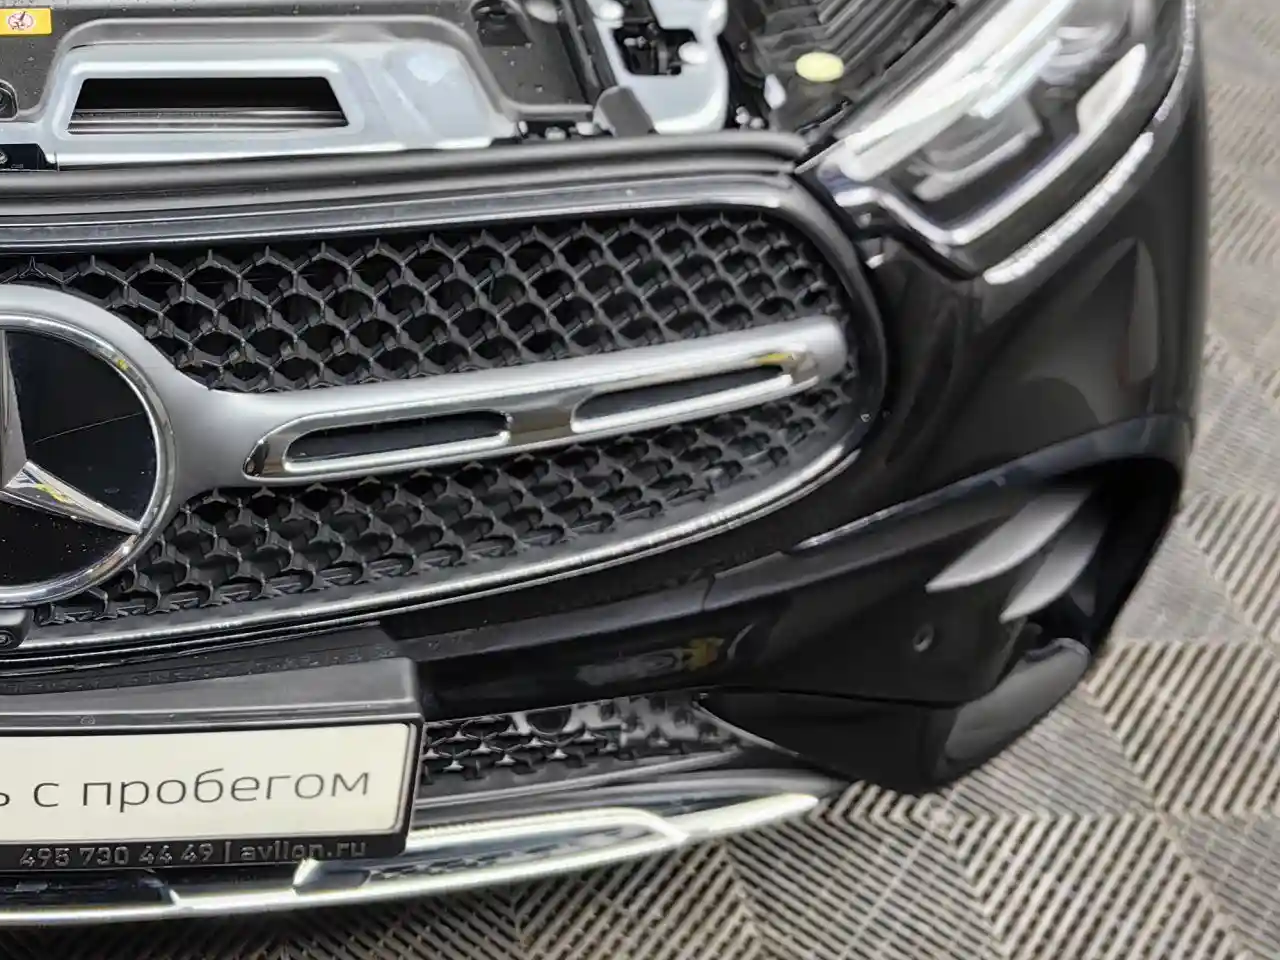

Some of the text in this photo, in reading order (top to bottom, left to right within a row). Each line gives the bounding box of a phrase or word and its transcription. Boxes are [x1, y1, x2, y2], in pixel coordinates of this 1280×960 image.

[33, 781, 60, 808] с
[82, 767, 370, 813] пробегом
[20, 847, 71, 867] 495
[79, 846, 130, 866] 730
[139, 844, 173, 864] 44
[180, 842, 214, 863] 49
[240, 839, 367, 862] avilon.ru
